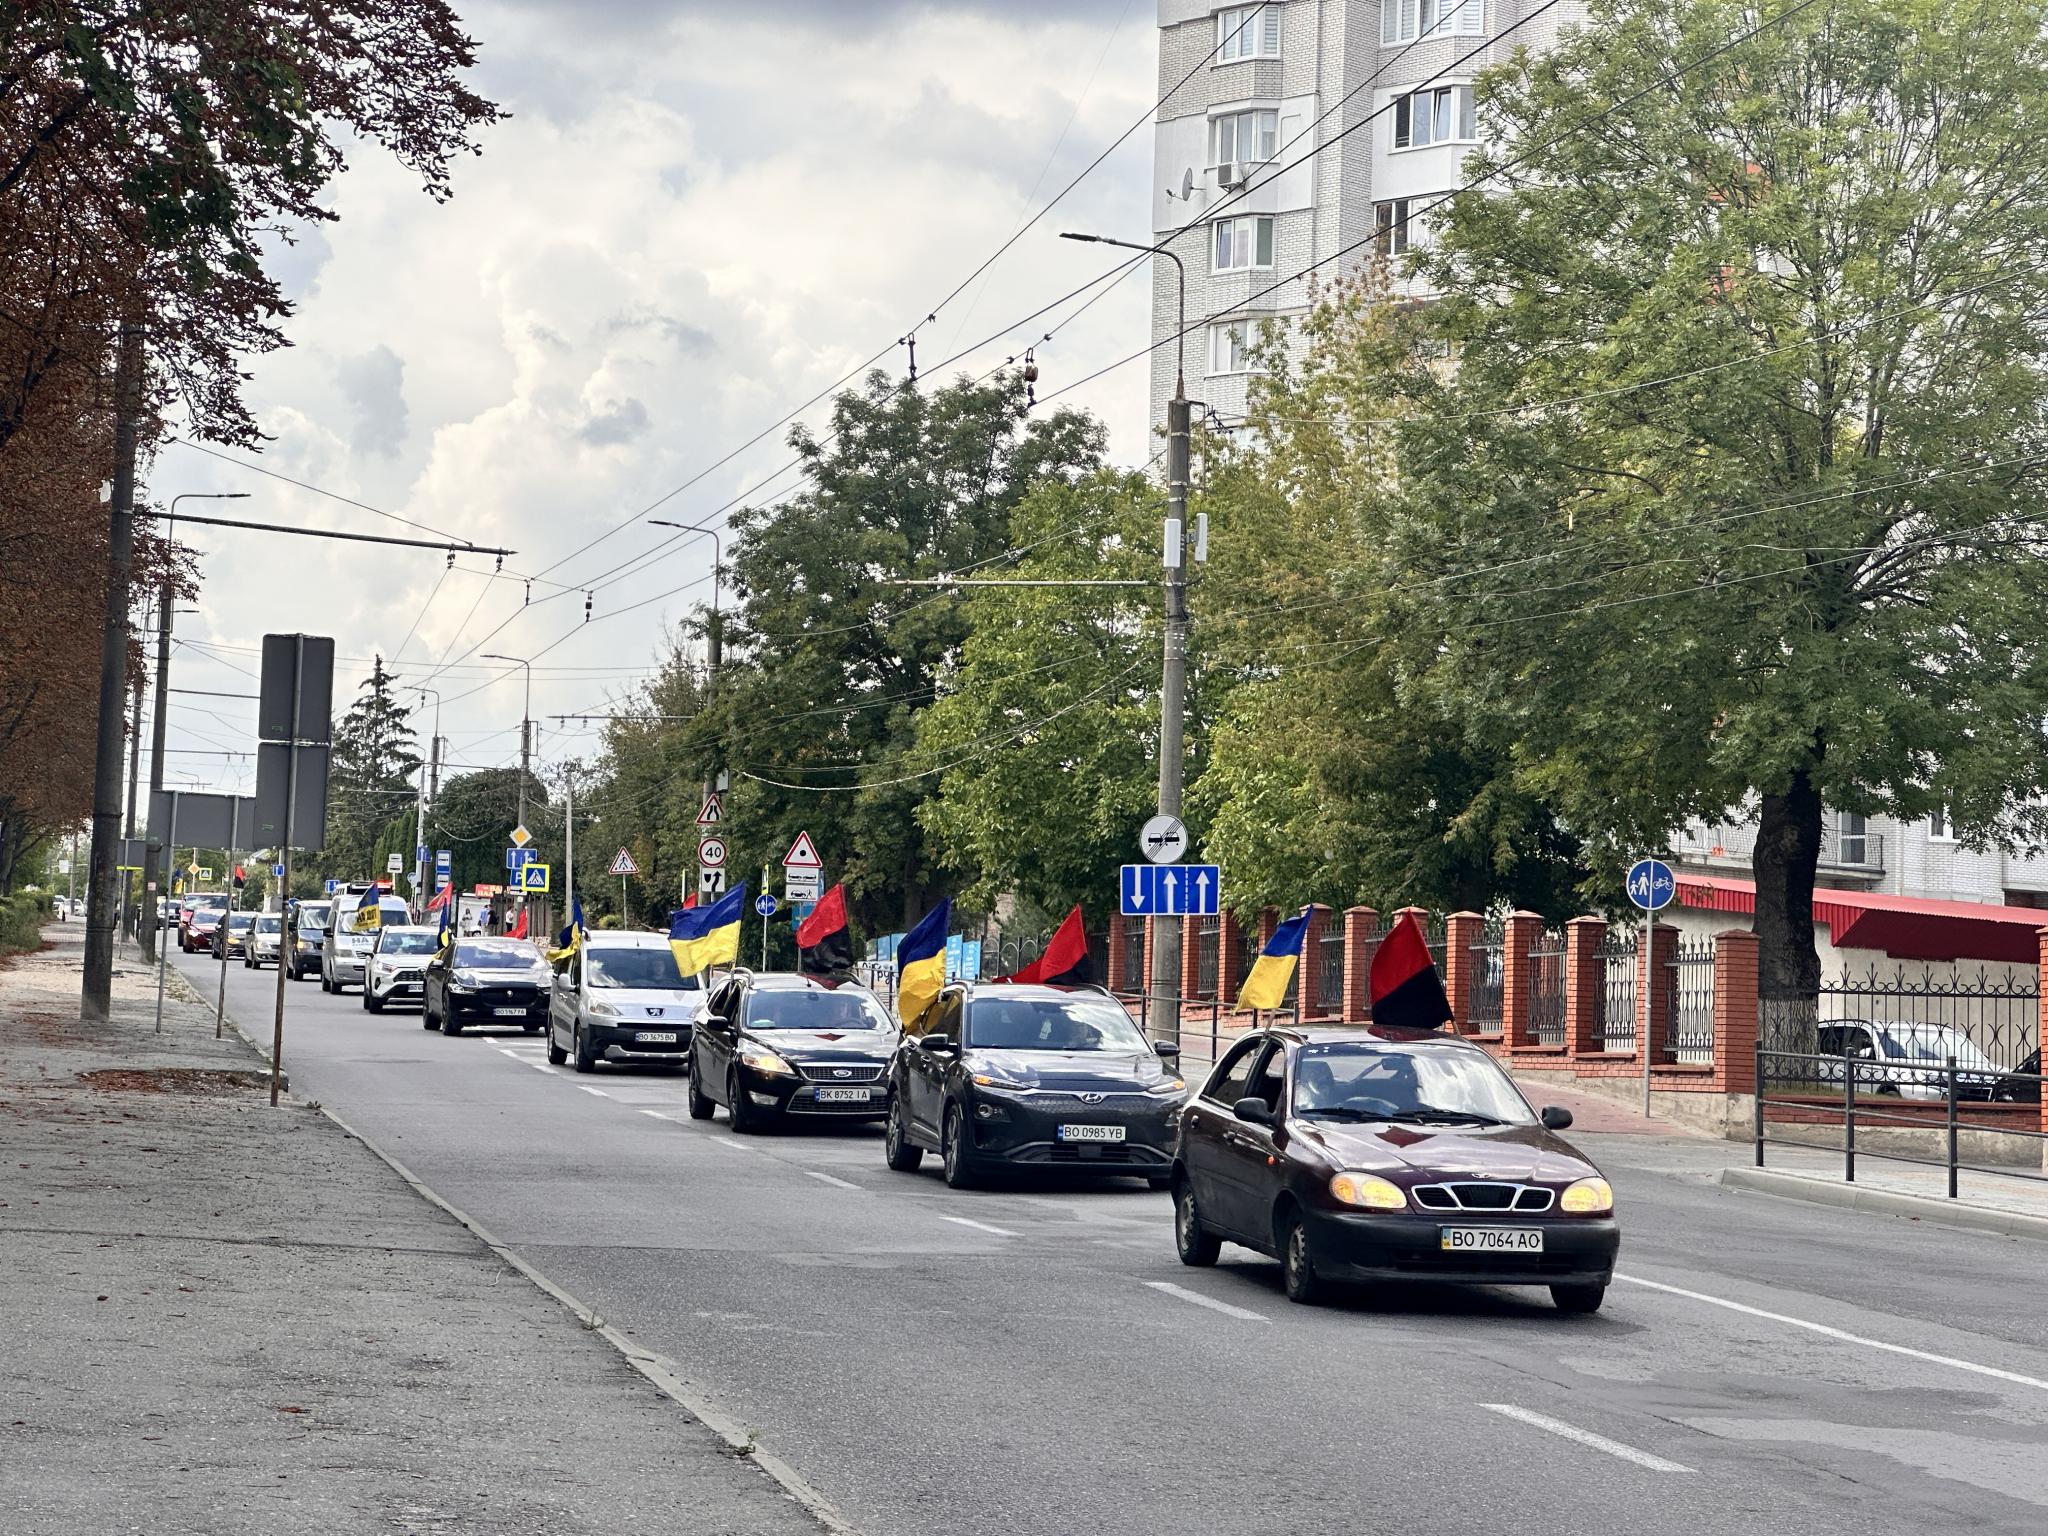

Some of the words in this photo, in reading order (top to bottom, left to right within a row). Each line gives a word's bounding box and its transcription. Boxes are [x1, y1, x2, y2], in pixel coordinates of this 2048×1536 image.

[705, 847, 722, 858] 40
[639, 1033, 649, 1041] BO
[820, 1090, 833, 1099] BK
[834, 1090, 853, 1099] 8752
[857, 1090, 868, 1099] IA
[1064, 1126, 1080, 1137] BO
[1082, 1127, 1106, 1138] 0985
[1108, 1128, 1123, 1139] YB
[1452, 1231, 1475, 1247] BO
[1479, 1232, 1514, 1248] 7064
[1517, 1233, 1539, 1248] AO
